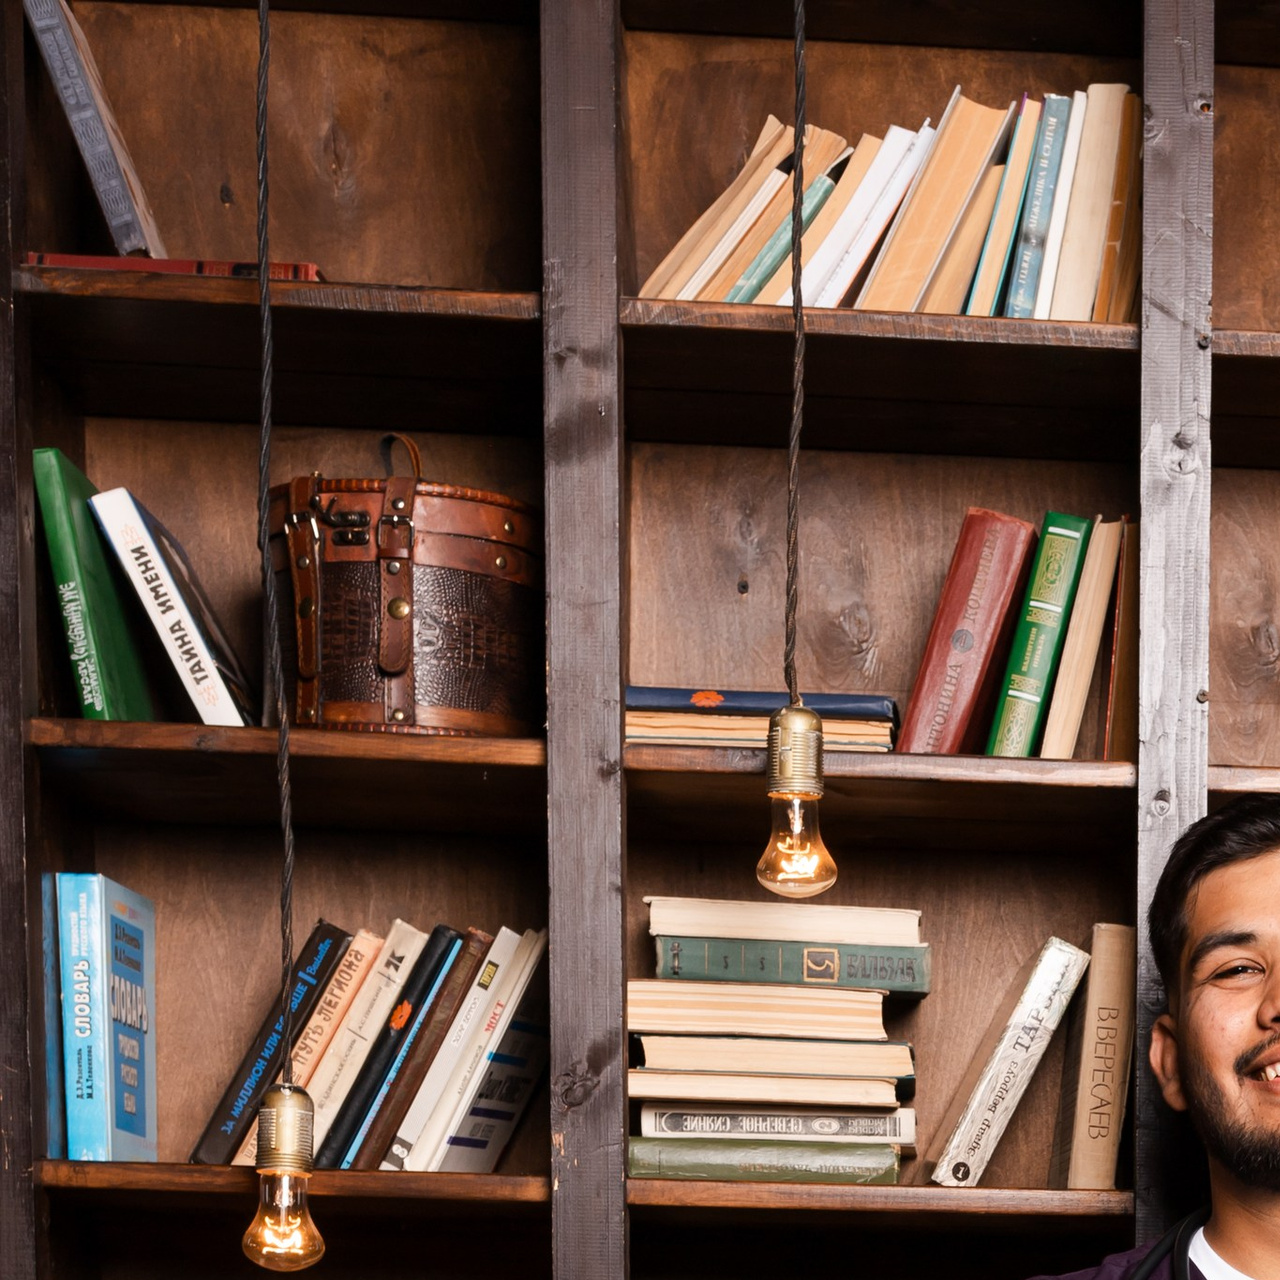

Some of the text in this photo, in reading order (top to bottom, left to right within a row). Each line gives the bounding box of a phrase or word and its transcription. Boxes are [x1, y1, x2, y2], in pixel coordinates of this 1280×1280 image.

[129, 542, 210, 688] ТАЙНА ИМЕНИ
[72, 958, 91, 1038] СЛОВАРЬ
[110, 973, 148, 1034] СЛОВАРЬ
[291, 946, 366, 1067] ПУТЬ ЛЕГИОНА
[846, 954, 917, 982] БАЛЬЗАК
[483, 999, 505, 1035] МОСТ
[219, 1116, 237, 1135] ЗА
[228, 1056, 268, 1118] МИЛЛИОН
[259, 1030, 283, 1060] ИЛИ
[963, 1116, 992, 1157] Эдгар
[985, 1058, 1021, 1115] Берроуз
[1086, 1005, 1120, 1142] В.ВЕРЕСАЕВ
[681, 1114, 803, 1132] СЕВЕРНОЕ СИЯНИЕ
